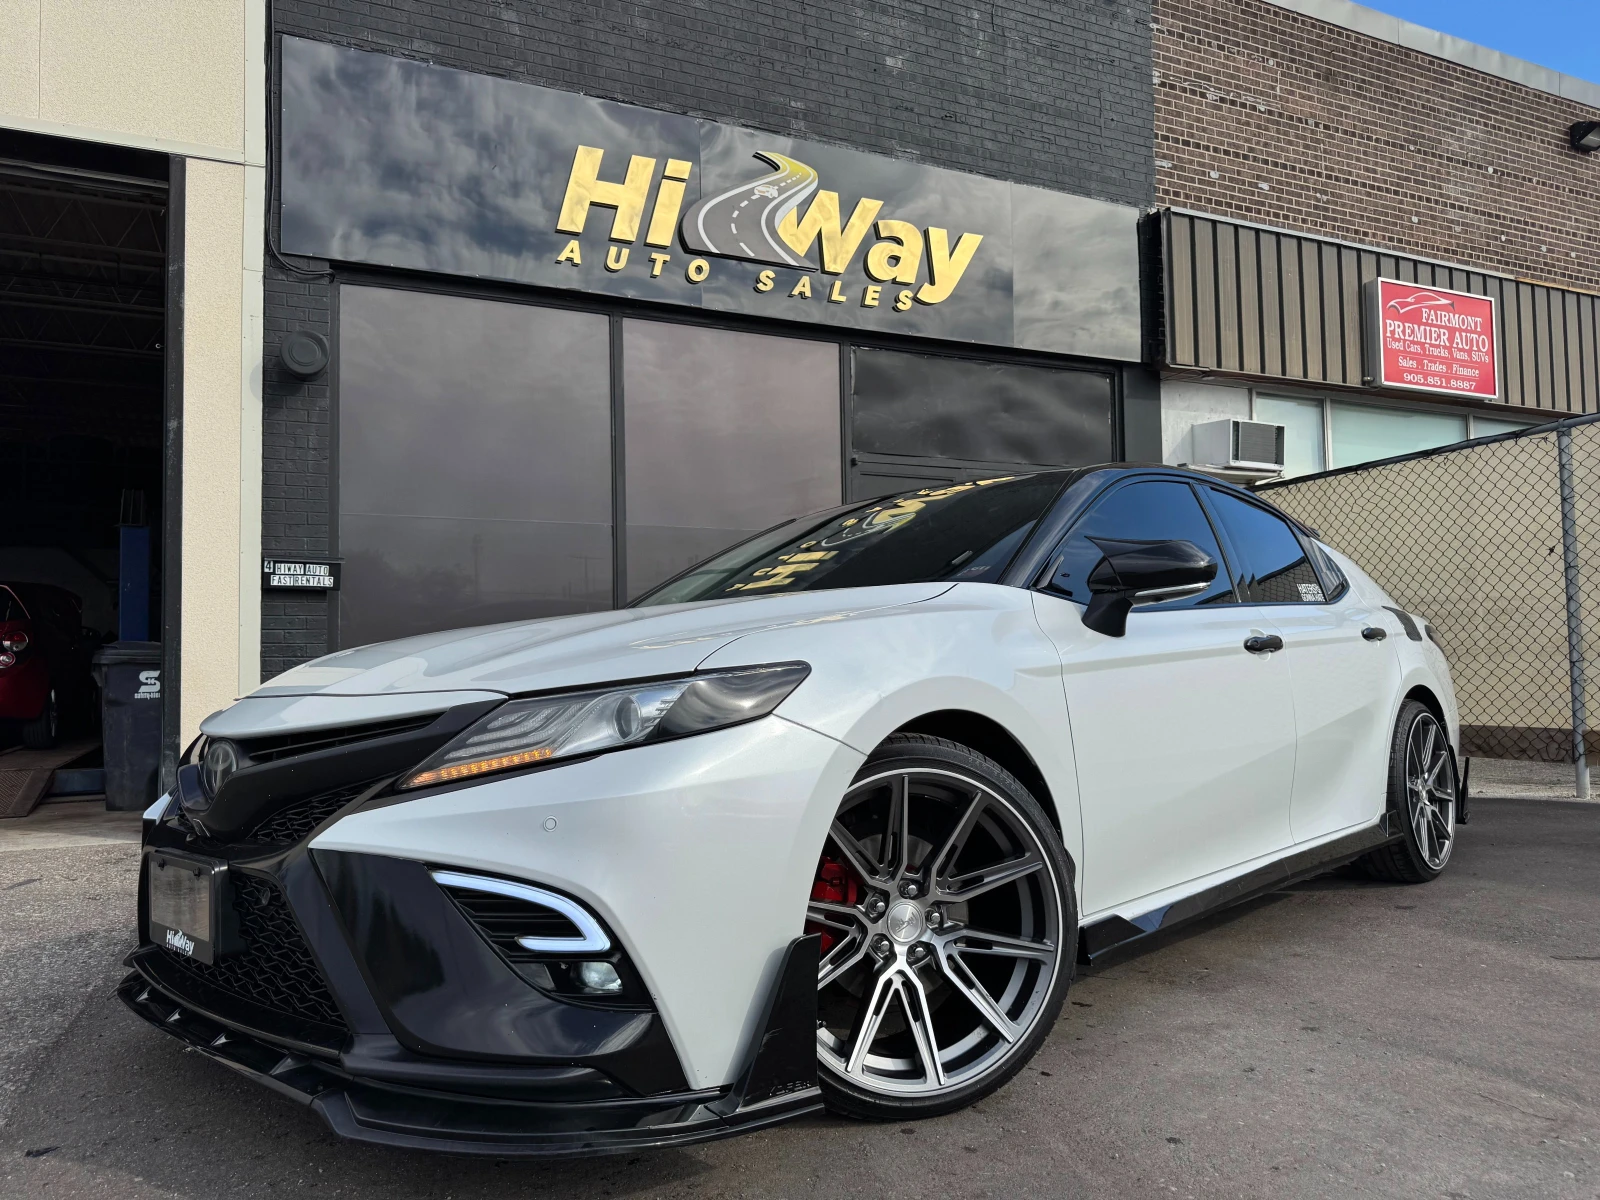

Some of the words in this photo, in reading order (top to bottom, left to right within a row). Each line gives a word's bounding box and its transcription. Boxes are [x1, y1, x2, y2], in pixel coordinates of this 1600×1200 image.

[555, 145, 693, 249] Hi
[774, 189, 984, 304] Way
[555, 239, 710, 284] AUTO
[754, 269, 915, 312] SALES
[1421, 308, 1482, 331] FAIRMONT
[1385, 319, 1450, 346] PREMIER
[1453, 331, 1489, 352] AUTO
[1386, 338, 1404, 349] Used
[1405, 341, 1423, 354] Cars,
[1424, 345, 1451, 359] Trucks,
[1452, 348, 1470, 361] Vans,
[1471, 351, 1489, 363] SUVs
[1398, 356, 1417, 368] Sales
[1423, 360, 1447, 373] Trades
[1452, 364, 1480, 377] Finance
[1403, 372, 1476, 390] 905.851.8887
[265, 561, 272, 572] 4
[276, 563, 303, 574] HIWAY
[306, 565, 329, 575] AUTO
[271, 575, 293, 585] FAST
[294, 576, 333, 587] RENTALS
